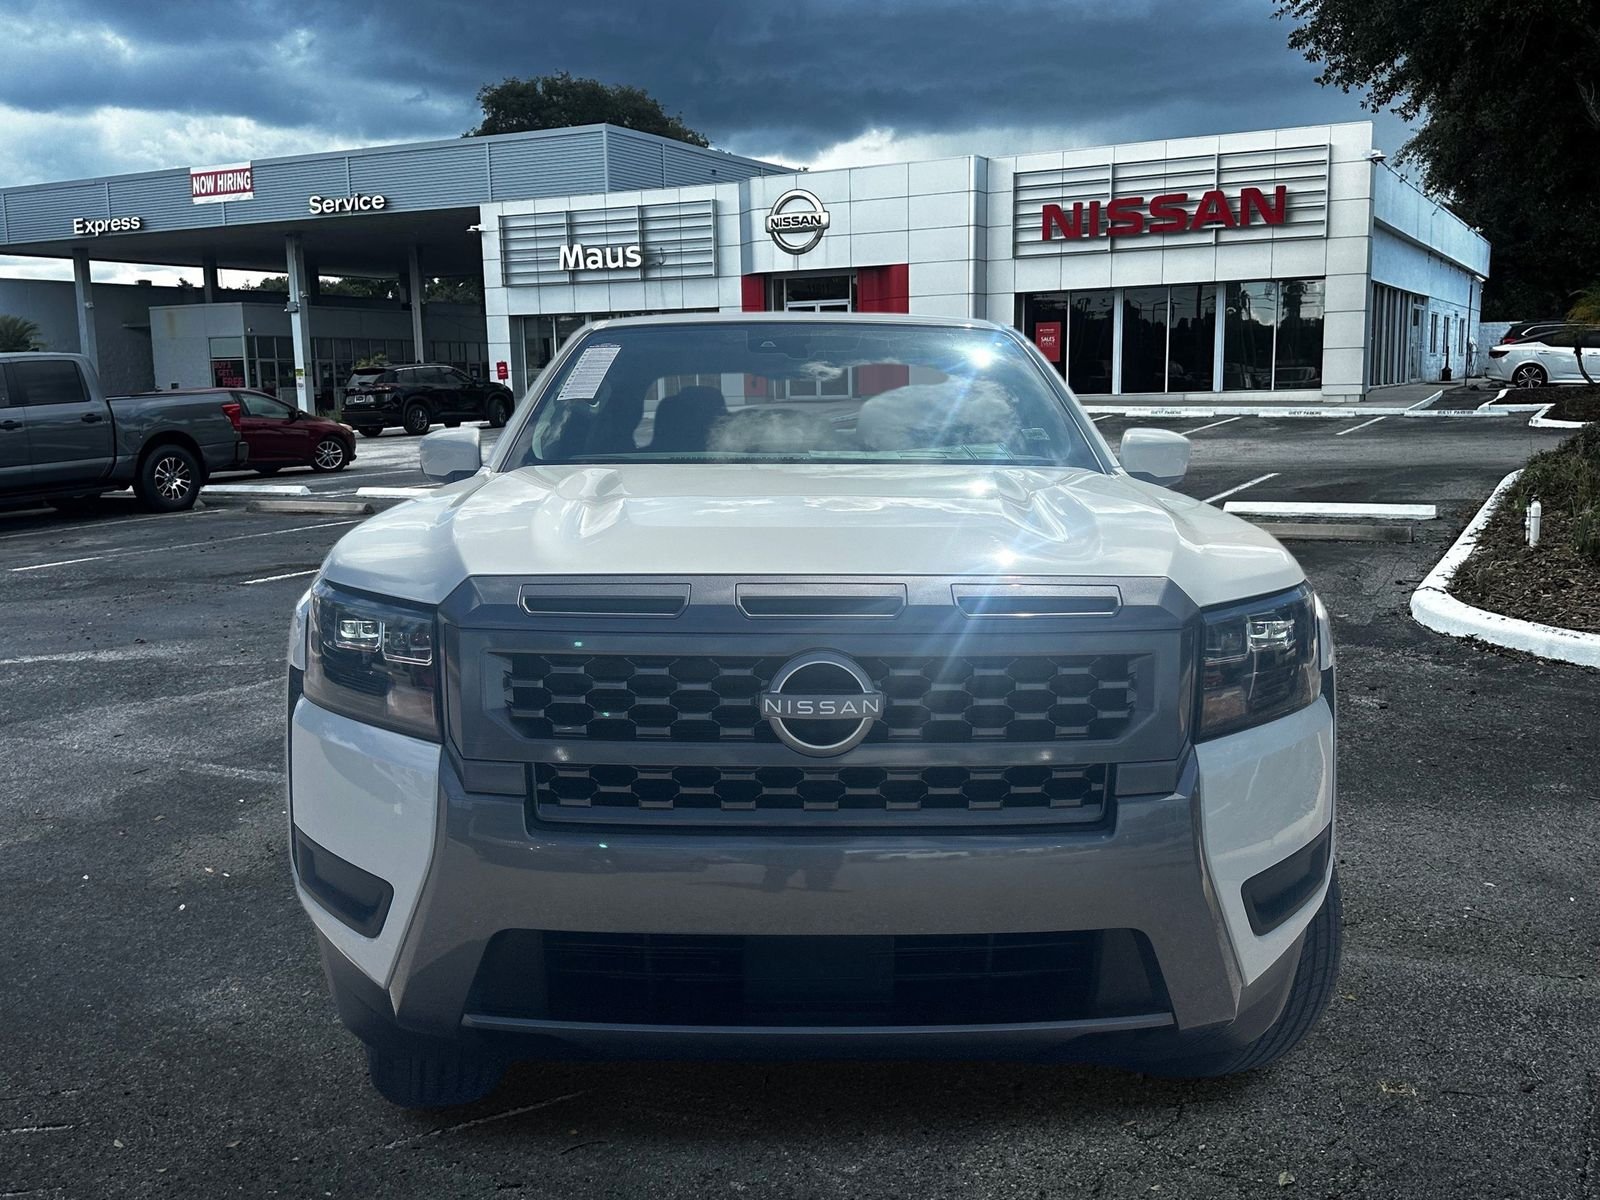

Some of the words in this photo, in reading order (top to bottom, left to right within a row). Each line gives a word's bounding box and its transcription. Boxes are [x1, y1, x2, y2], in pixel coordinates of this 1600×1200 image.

[193, 175, 215, 195] NOW
[217, 171, 251, 192] HIRING
[309, 193, 386, 215] Service
[1042, 185, 1287, 241] NISSAN
[73, 215, 142, 237] Express
[770, 215, 822, 228] NISSAN
[560, 243, 642, 271] Maus
[222, 377, 244, 387] FREE
[764, 698, 880, 715] NISSAN
